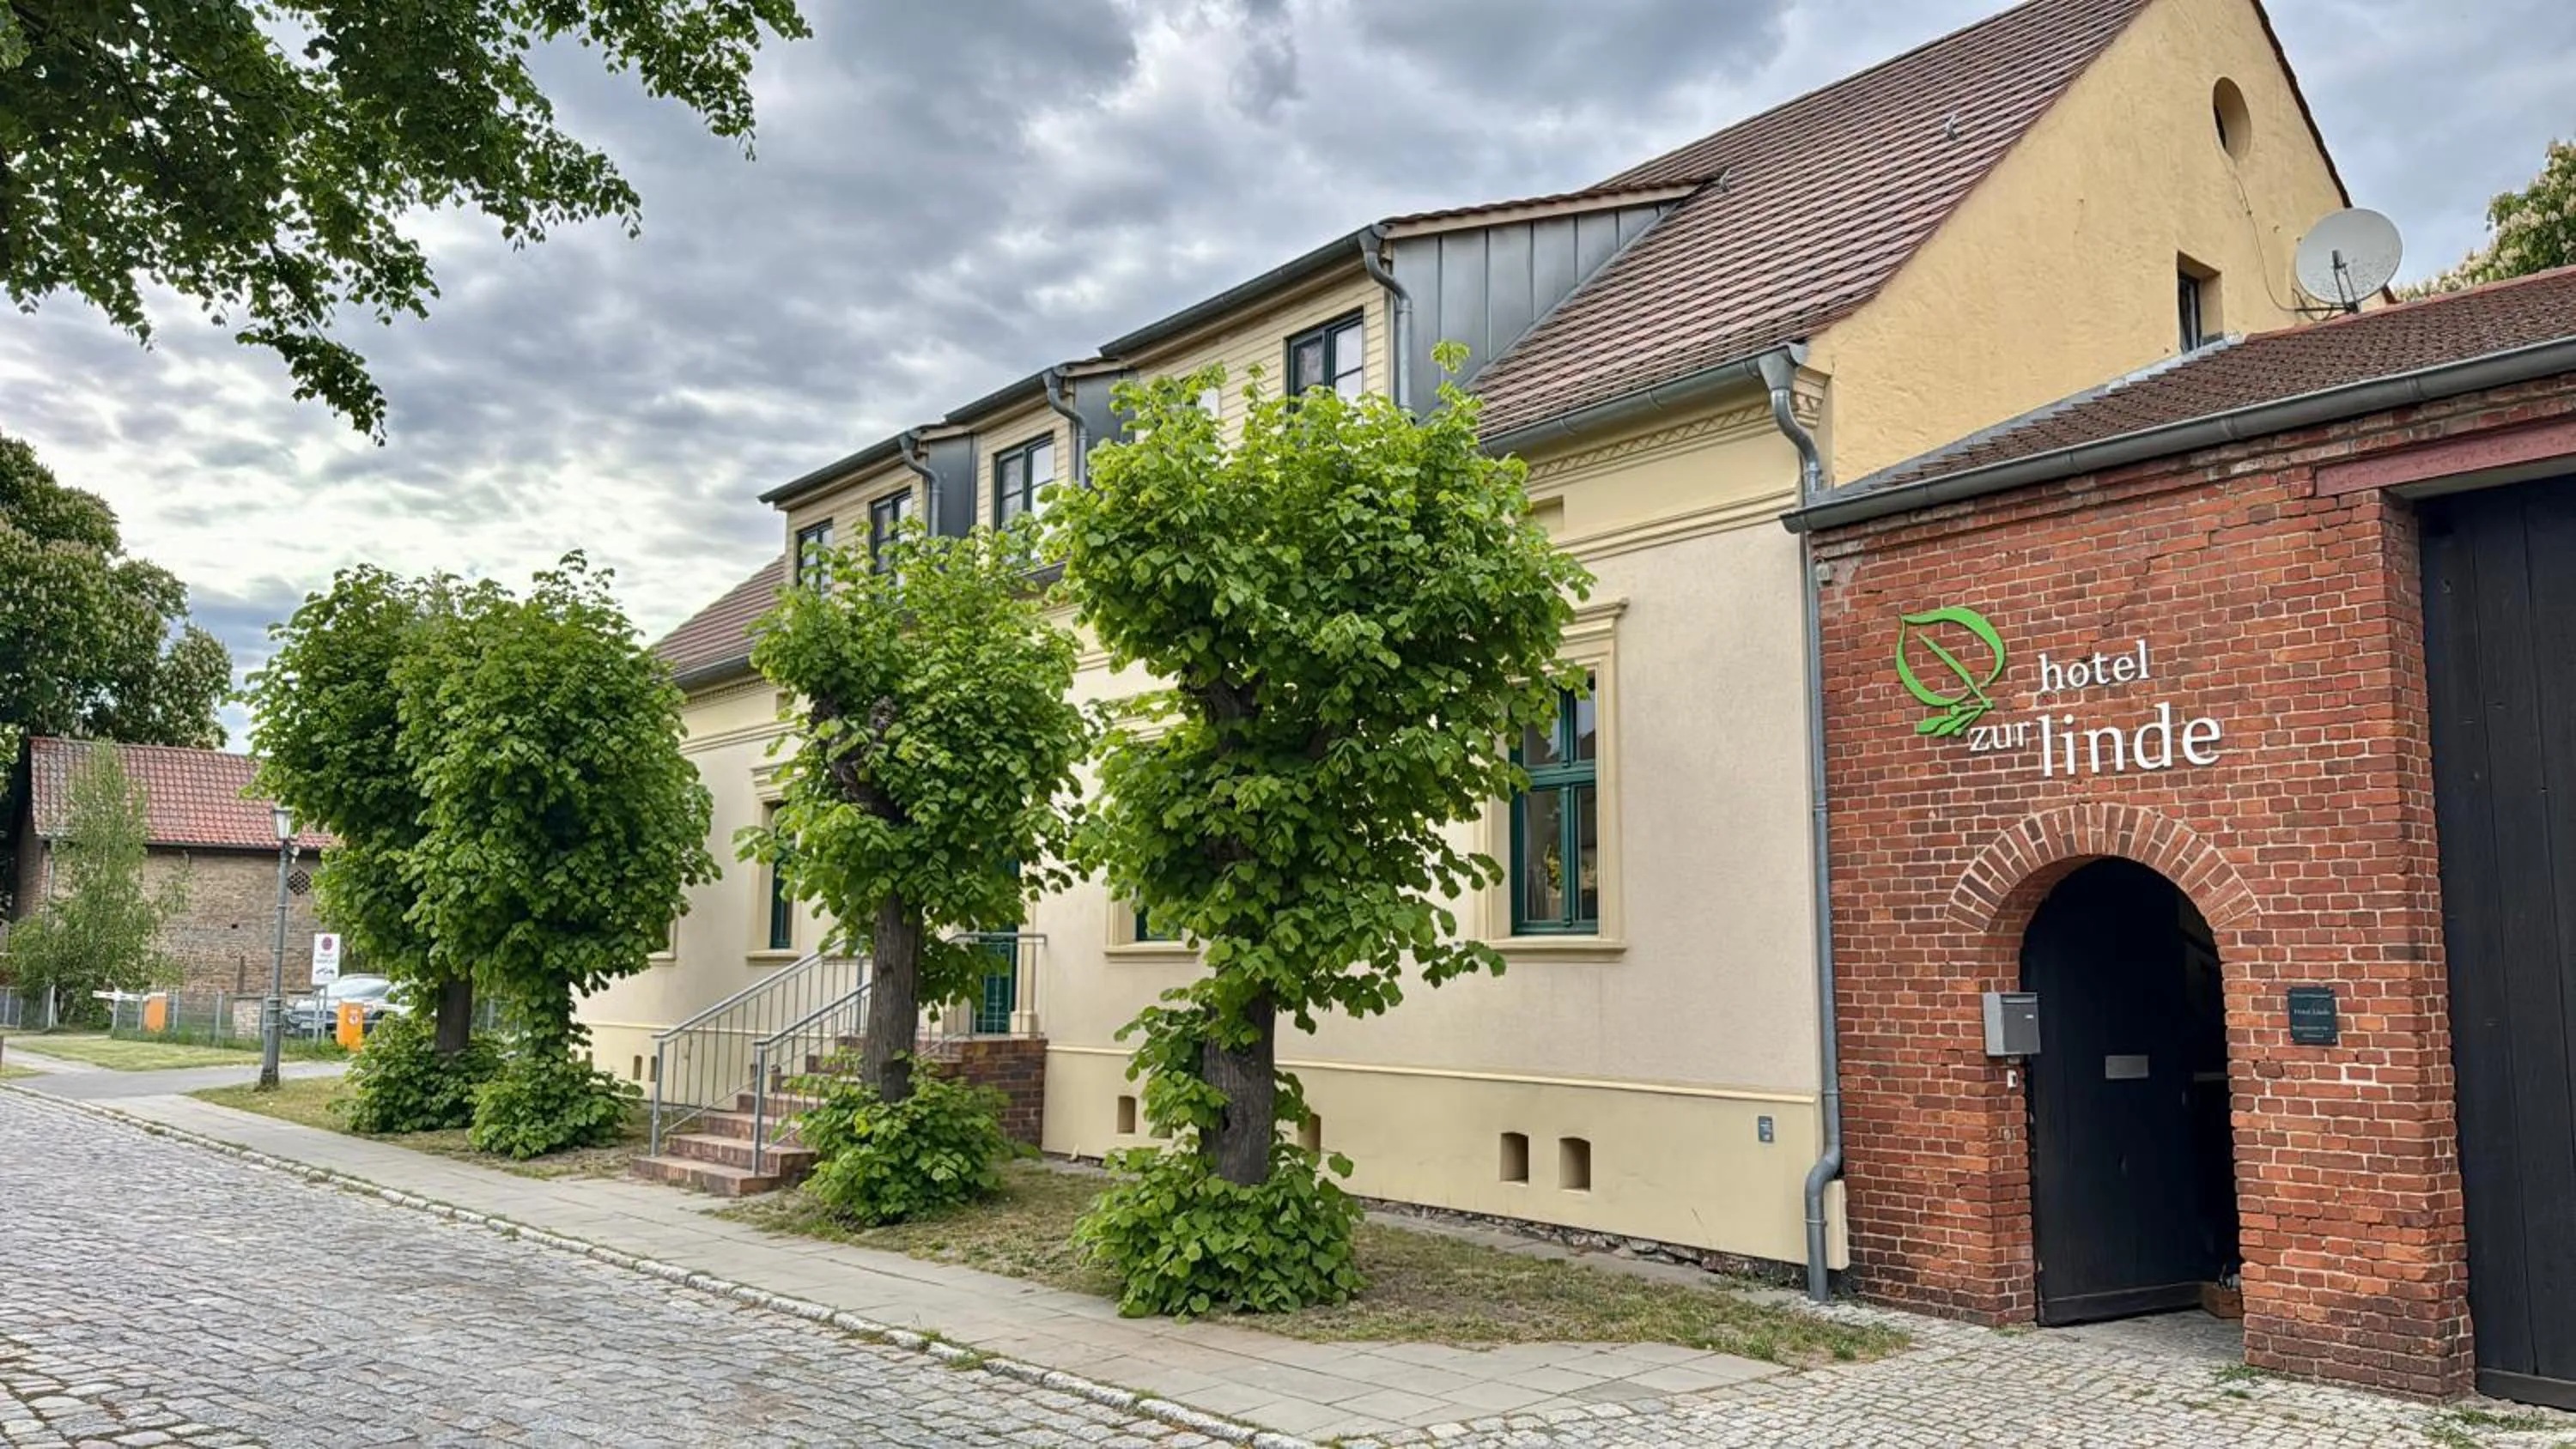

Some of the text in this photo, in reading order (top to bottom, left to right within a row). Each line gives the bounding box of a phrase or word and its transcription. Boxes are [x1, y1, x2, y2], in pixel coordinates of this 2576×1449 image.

[2038, 640, 2149, 693] hotel
[1969, 702, 2221, 777] zur linde
